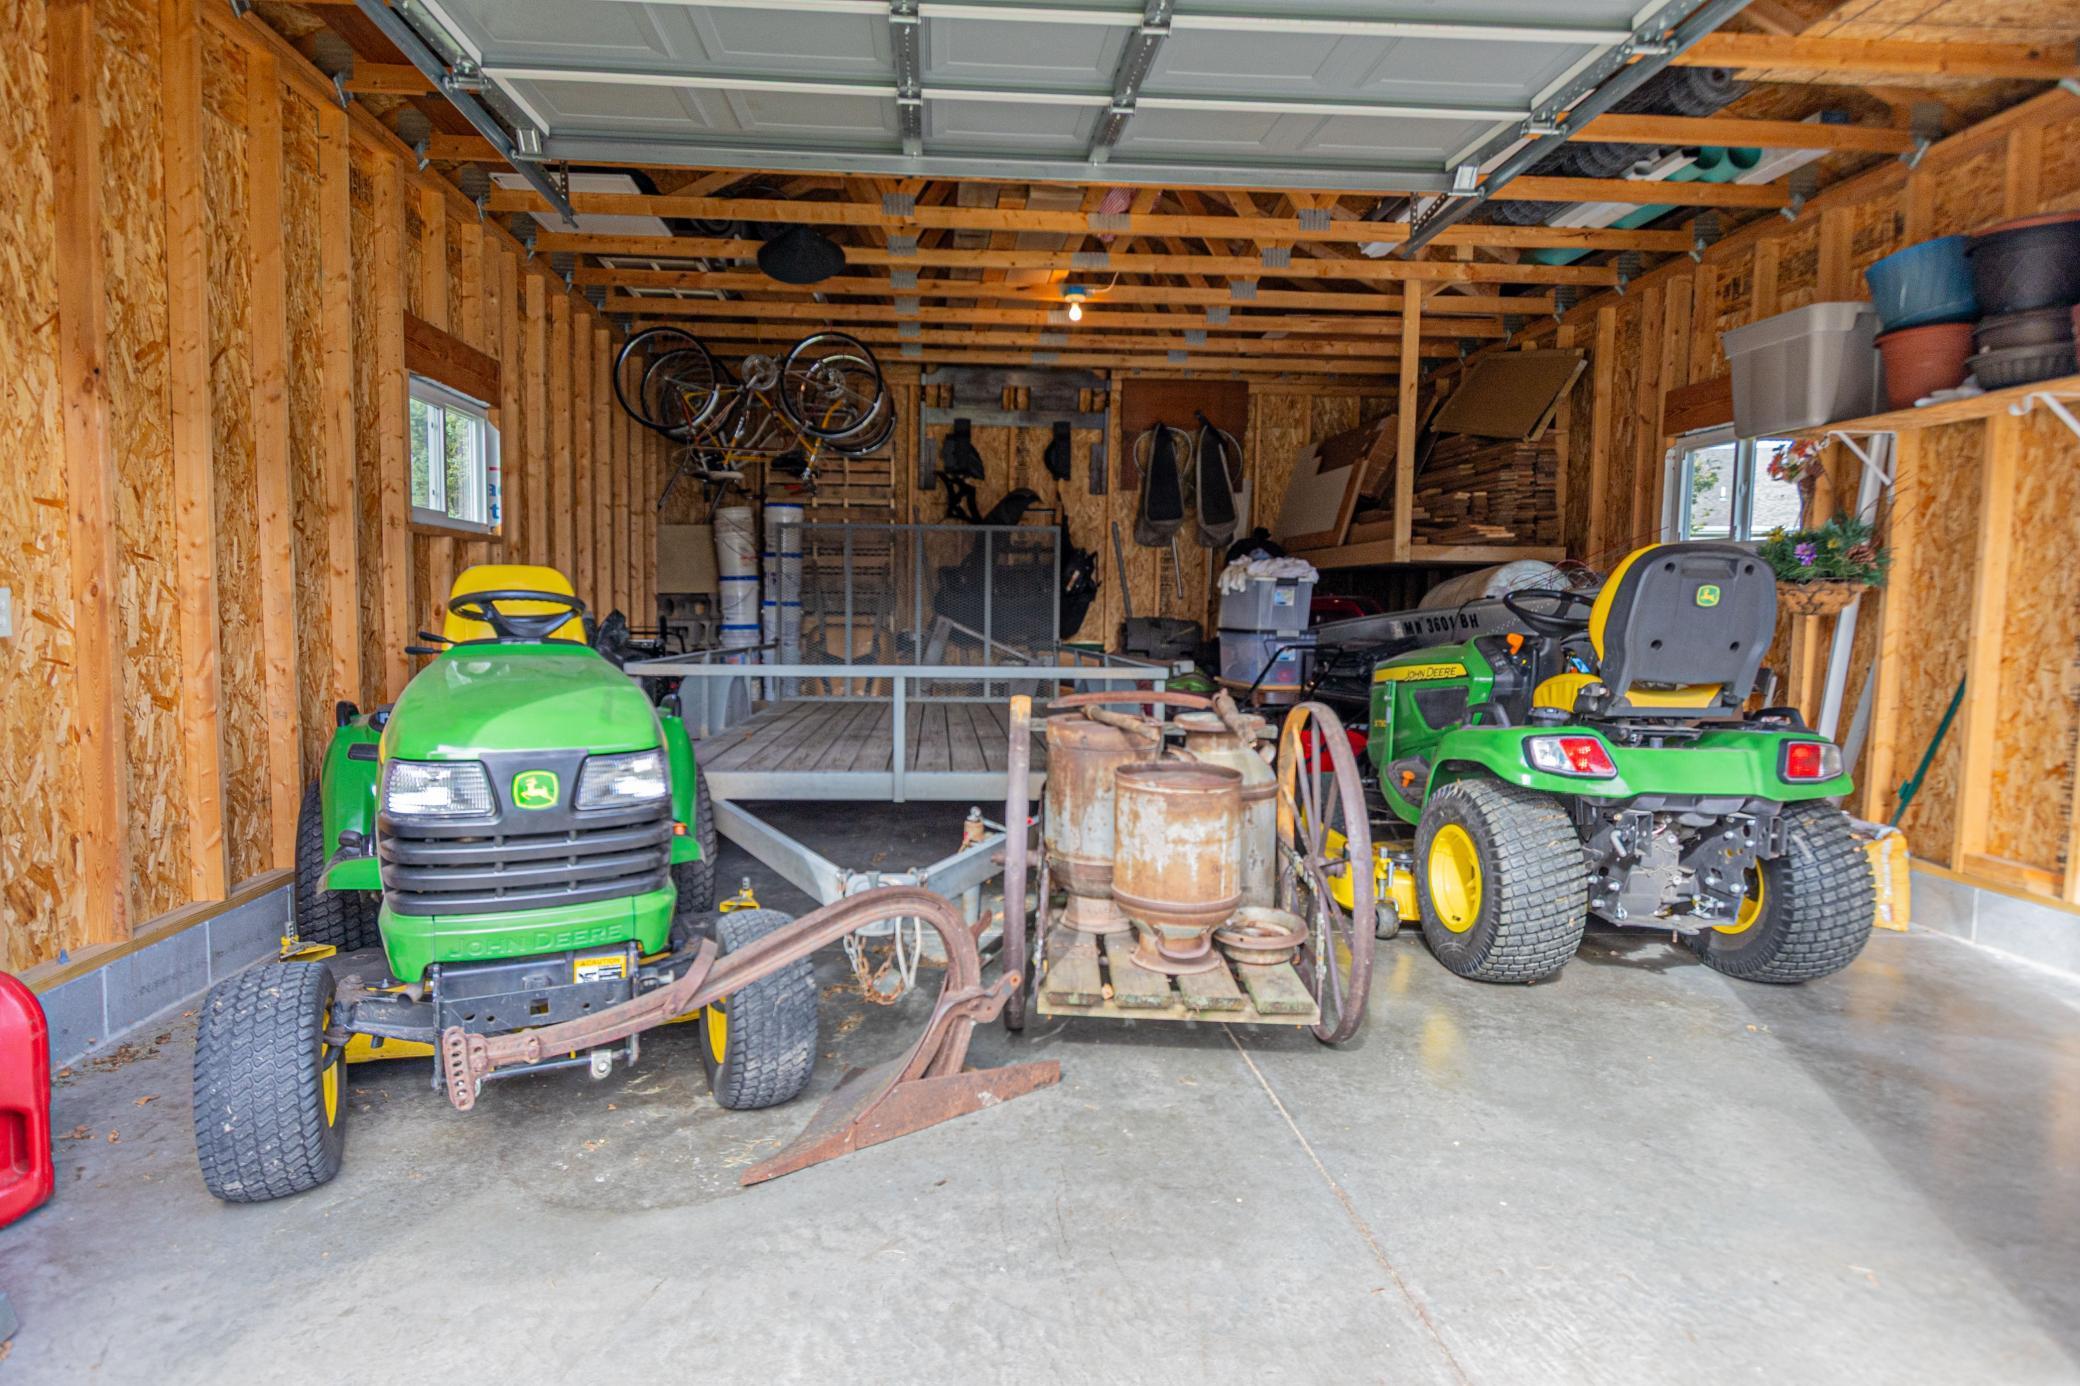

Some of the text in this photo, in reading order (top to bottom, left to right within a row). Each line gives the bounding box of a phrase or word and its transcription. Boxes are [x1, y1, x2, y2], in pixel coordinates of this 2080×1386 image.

[1427, 616, 1455, 633] 3601
[1460, 613, 1479, 629] BH
[1406, 667, 1457, 680] JOHN DEERE
[450, 925, 623, 957] JOHN DEERE
